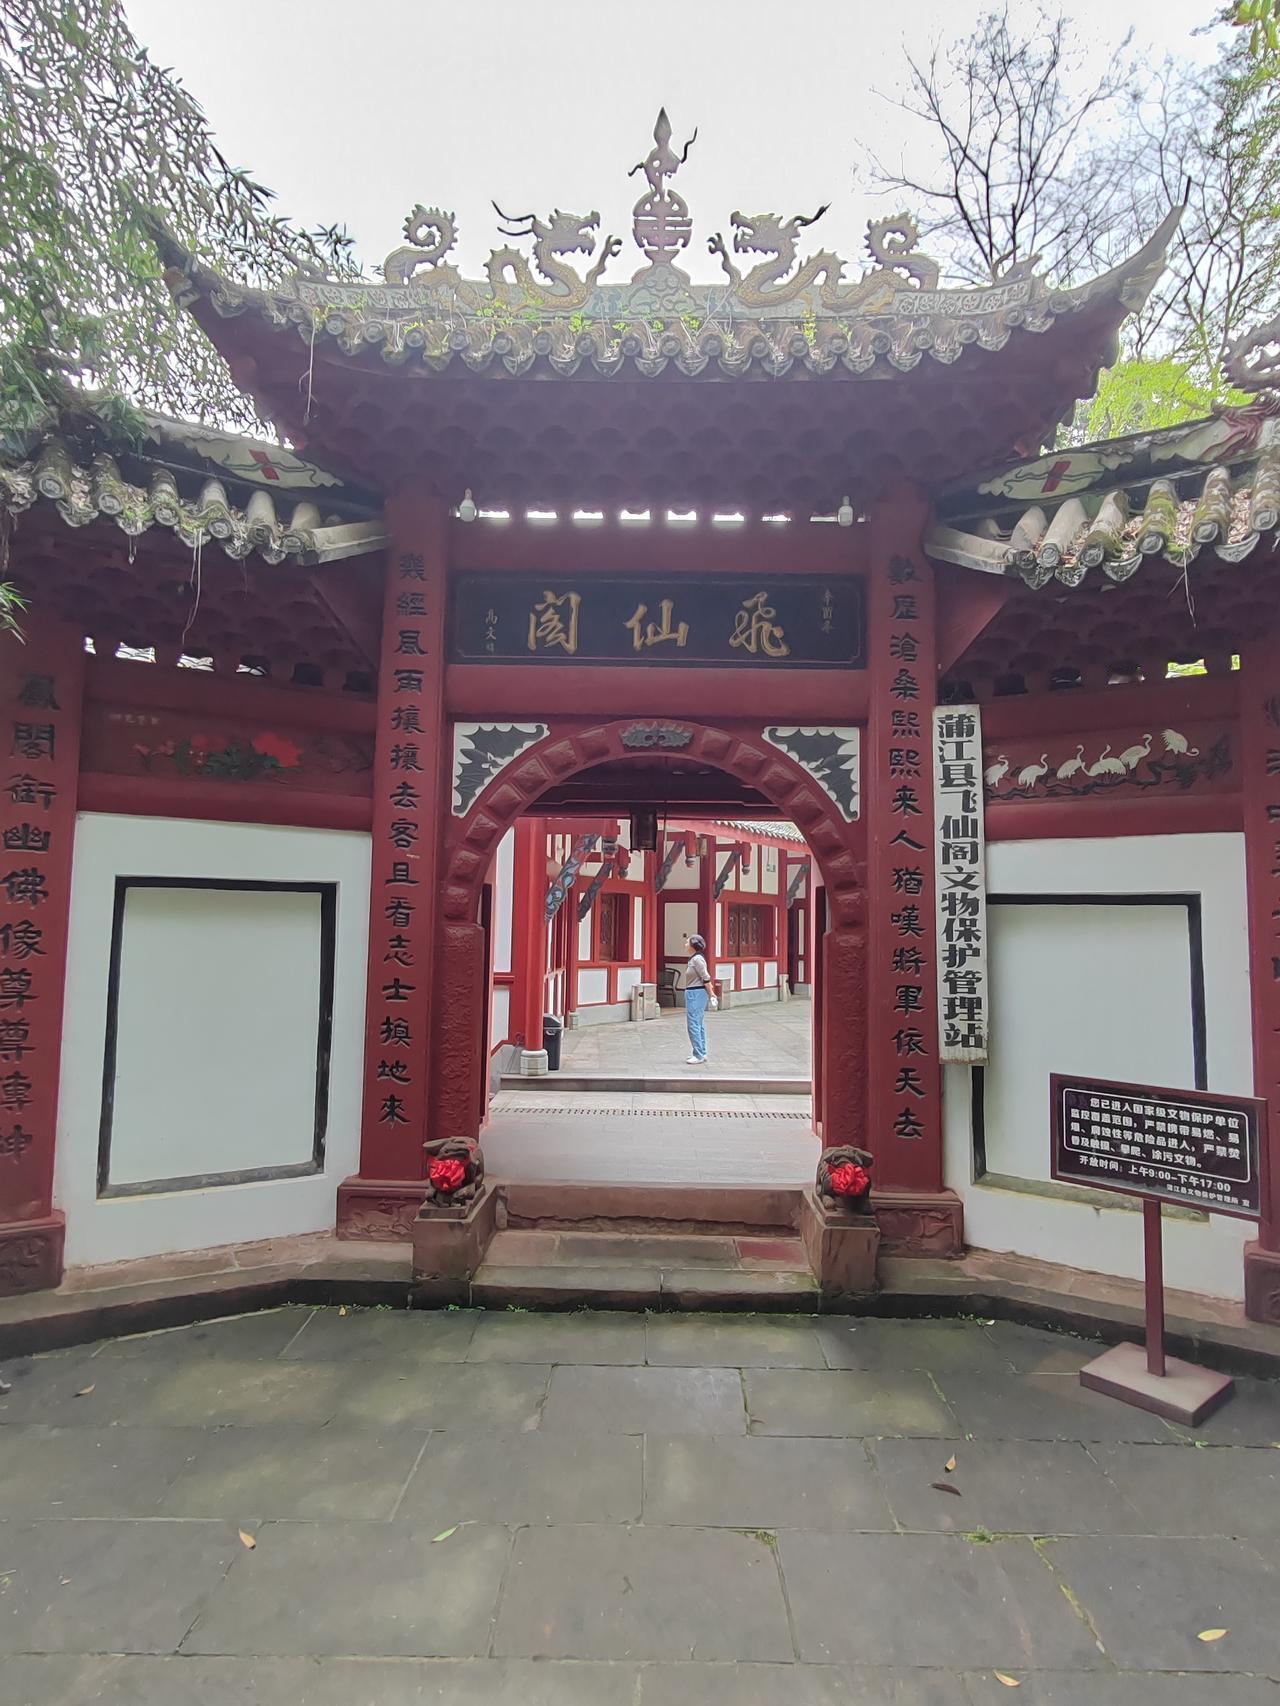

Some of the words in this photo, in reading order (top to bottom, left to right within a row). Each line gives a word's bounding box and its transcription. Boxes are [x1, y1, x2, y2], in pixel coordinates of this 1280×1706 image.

[935, 712, 984, 1050] 蒲江县飞仙阁文物保护管理站
[1089, 1096, 1240, 1129] 您已进入国家级文物保护单位
